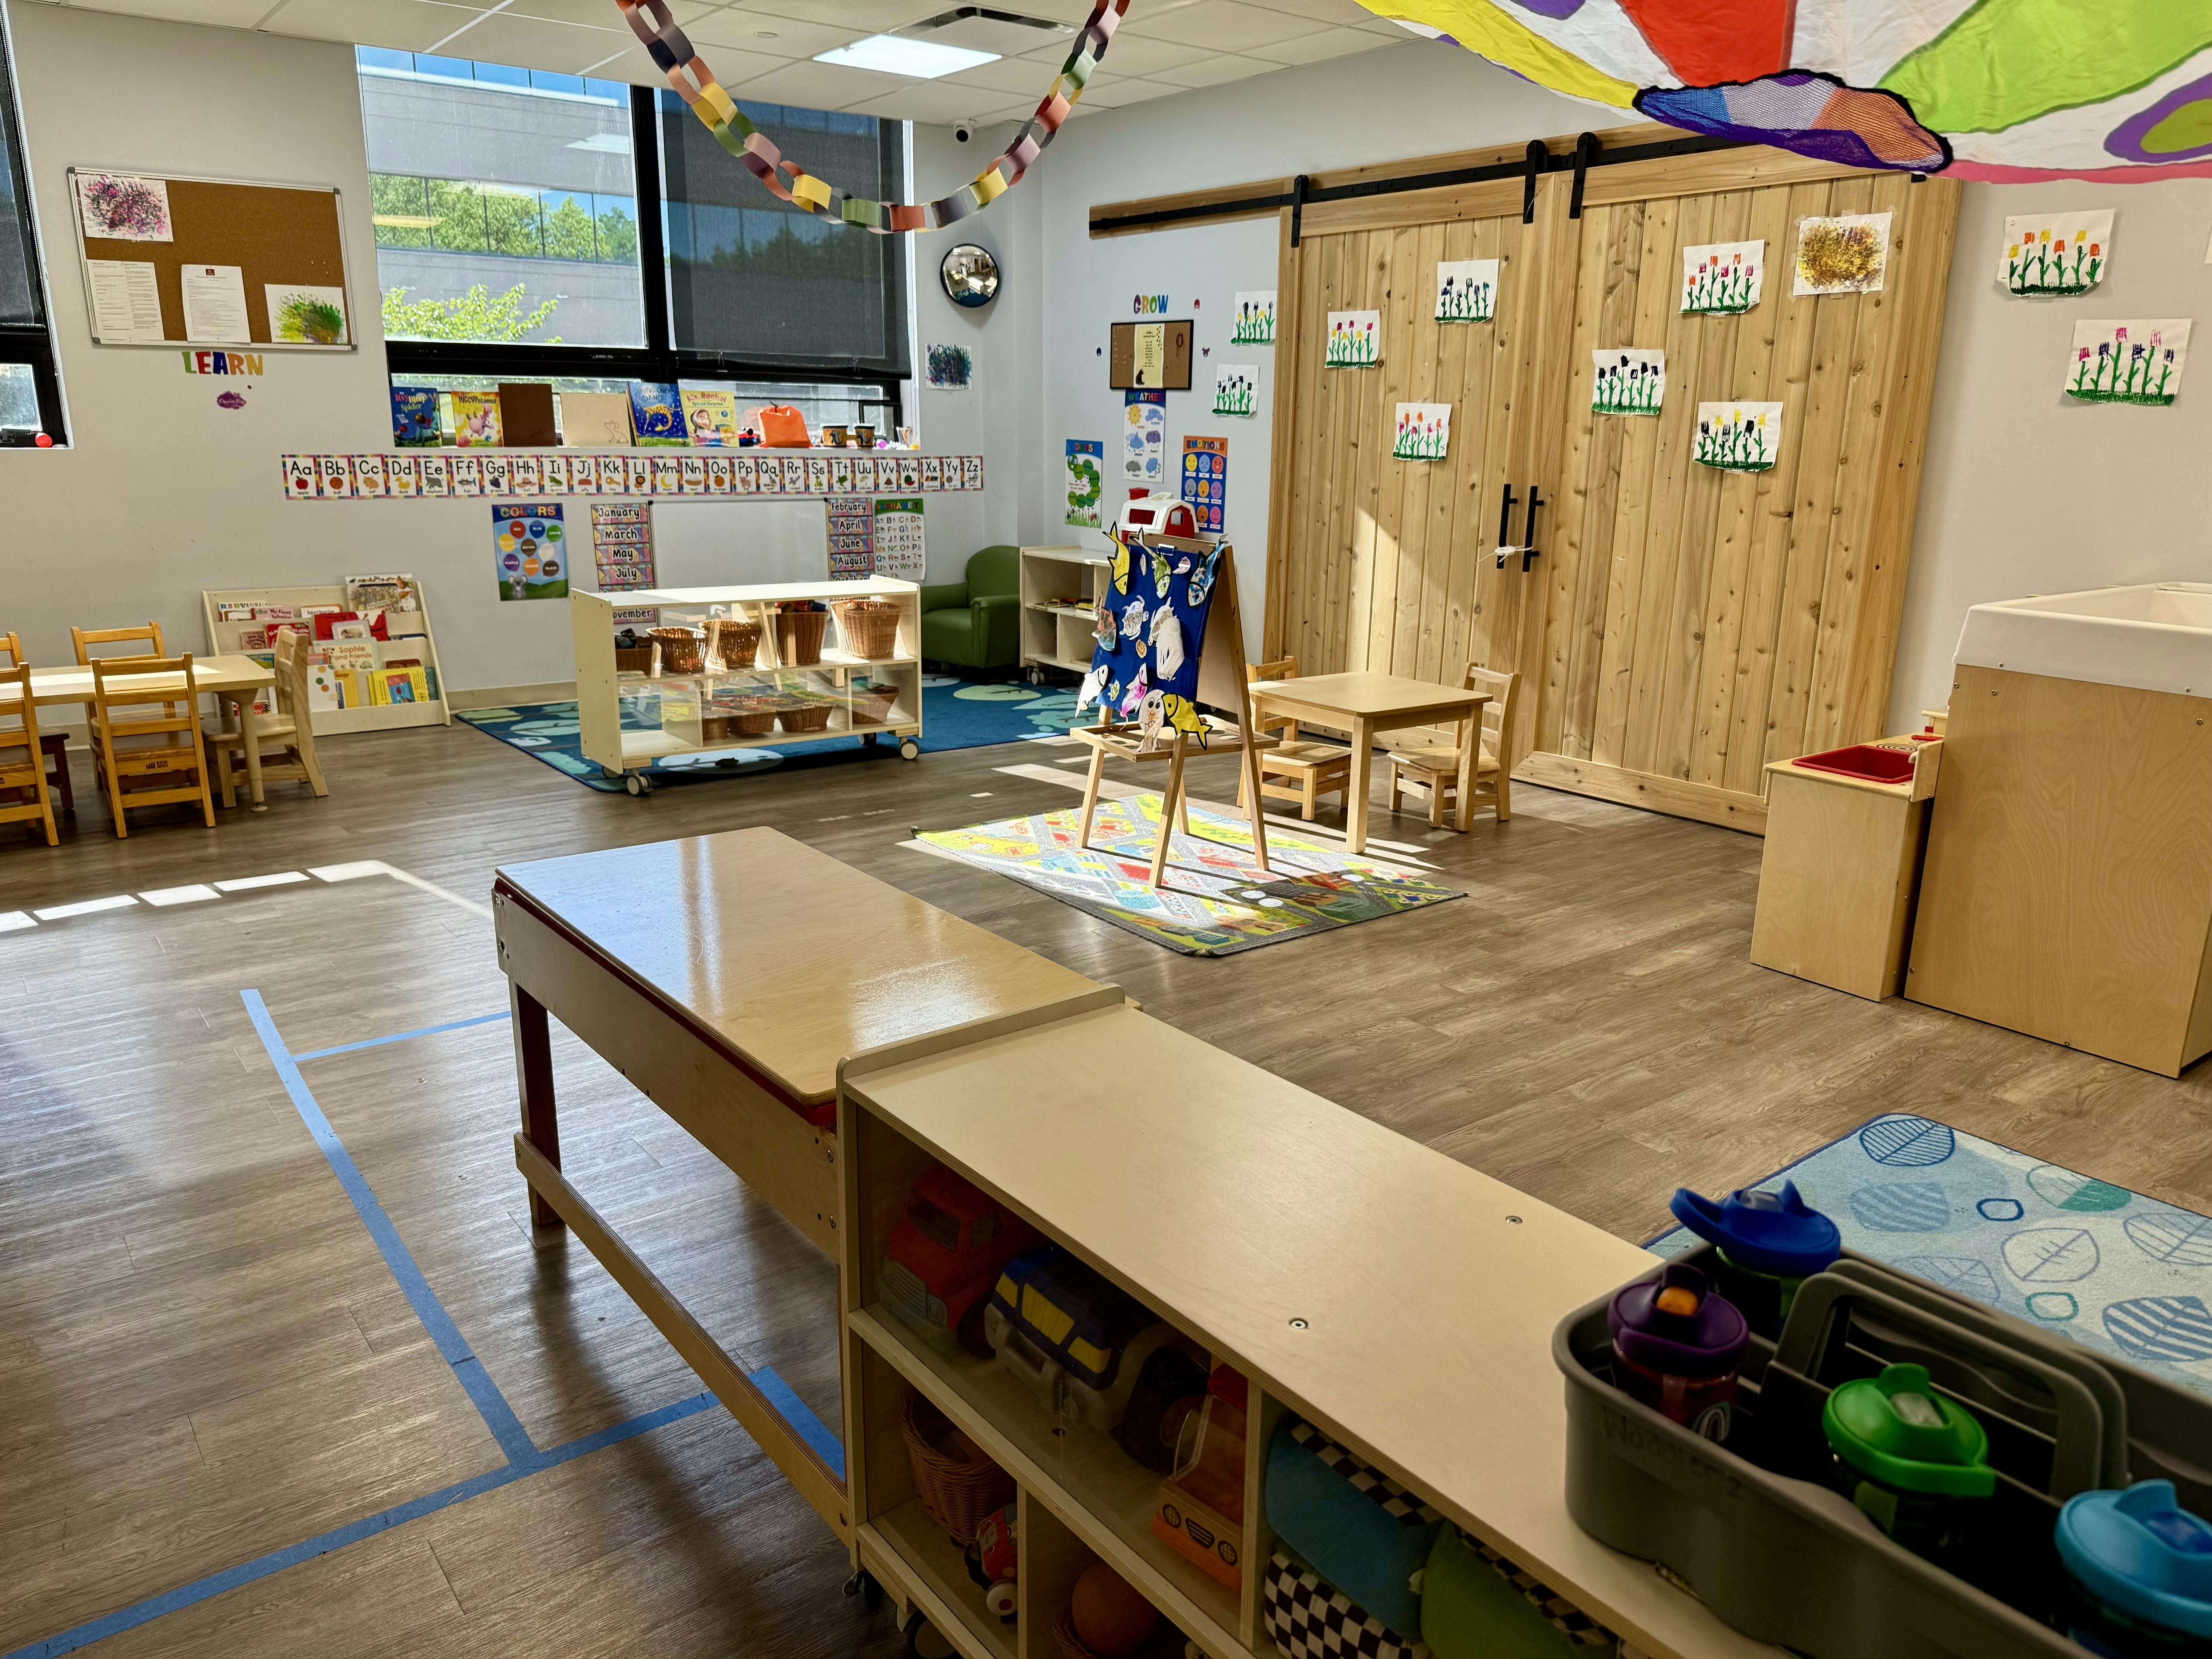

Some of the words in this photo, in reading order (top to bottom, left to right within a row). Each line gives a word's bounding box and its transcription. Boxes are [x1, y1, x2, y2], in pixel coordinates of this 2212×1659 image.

[1133, 294, 1168, 314] GROW
[182, 351, 263, 376] LEARN
[1128, 393, 1164, 402] WEATHER
[401, 403, 422, 412] Spider
[1075, 442, 1093, 453] DAYS
[1187, 440, 1224, 451] EMOTIONS
[290, 460, 312, 475] Aa
[325, 460, 345, 475] Bb
[359, 460, 379, 474] Cc
[392, 461, 412, 475] Dd
[424, 461, 443, 475] Ee
[456, 461, 474, 475] Ff
[486, 461, 505, 477] Gg
[517, 460, 534, 474] Hh
[550, 460, 560, 474] Ii
[577, 460, 590, 477] Jj
[604, 460, 620, 474] Kk
[634, 462, 644, 474] Ll
[656, 462, 677, 474] Mm
[685, 461, 701, 474] Nn
[711, 461, 727, 474] Oo
[738, 461, 752, 477] Pp
[761, 461, 778, 477] Qq
[787, 461, 801, 474] Rr
[812, 462, 824, 475] Ss
[835, 462, 848, 474] Tt
[858, 462, 871, 474] Uu
[881, 462, 894, 474] Vv
[901, 463, 917, 473] Ww
[926, 461, 937, 473] Xx
[946, 460, 958, 475] Yy
[967, 460, 978, 472] Zz
[500, 506, 556, 517] COLORS
[598, 507, 640, 520] January
[832, 503, 866, 513] February
[840, 520, 860, 531] April
[605, 528, 637, 540] March
[841, 539, 860, 549] June
[613, 549, 634, 561] May
[838, 555, 867, 567] August
[616, 568, 637, 580] July
[613, 609, 651, 619] ovember
[339, 646, 365, 654] Sophie
[1726, 1475, 1747, 1501] 2
